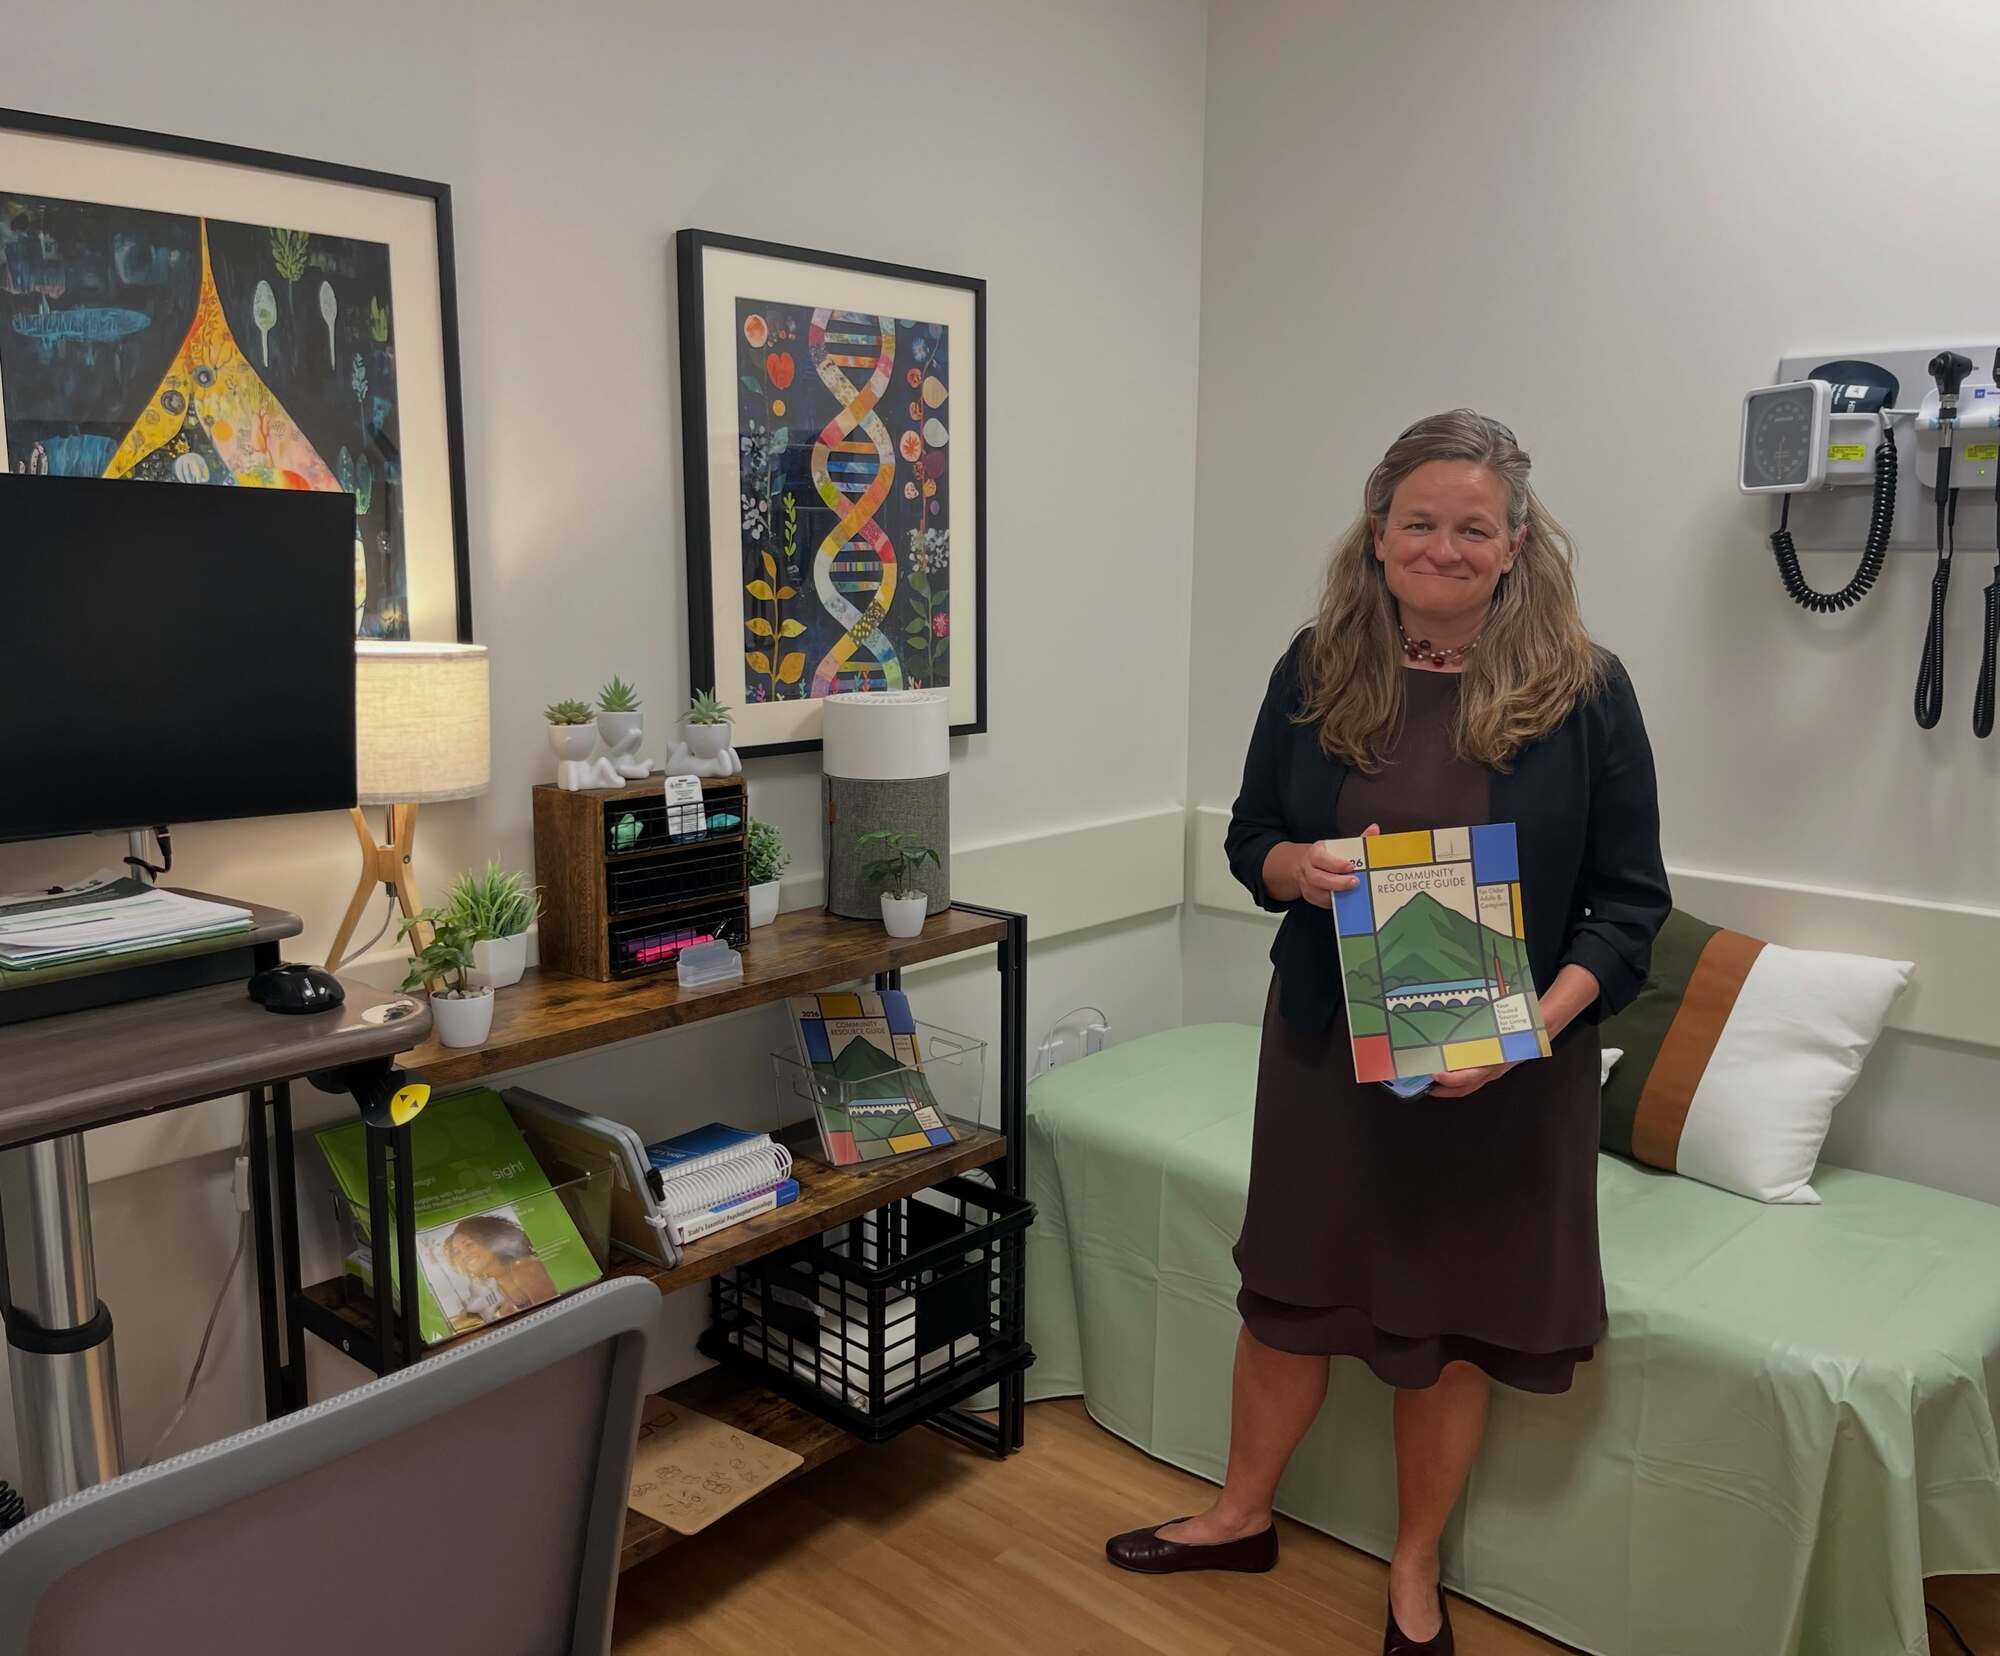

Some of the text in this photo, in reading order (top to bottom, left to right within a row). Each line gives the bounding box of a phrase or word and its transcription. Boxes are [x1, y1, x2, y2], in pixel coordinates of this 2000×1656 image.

[1387, 868, 1454, 882] COMMUNITY
[1377, 877, 1465, 893] RESOURCE GUIDE
[831, 1027, 885, 1036] RESOURCE GUIDE
[492, 1160, 526, 1180] sight
[688, 1200, 773, 1236] Stahl's Essential Psychopharmacology
